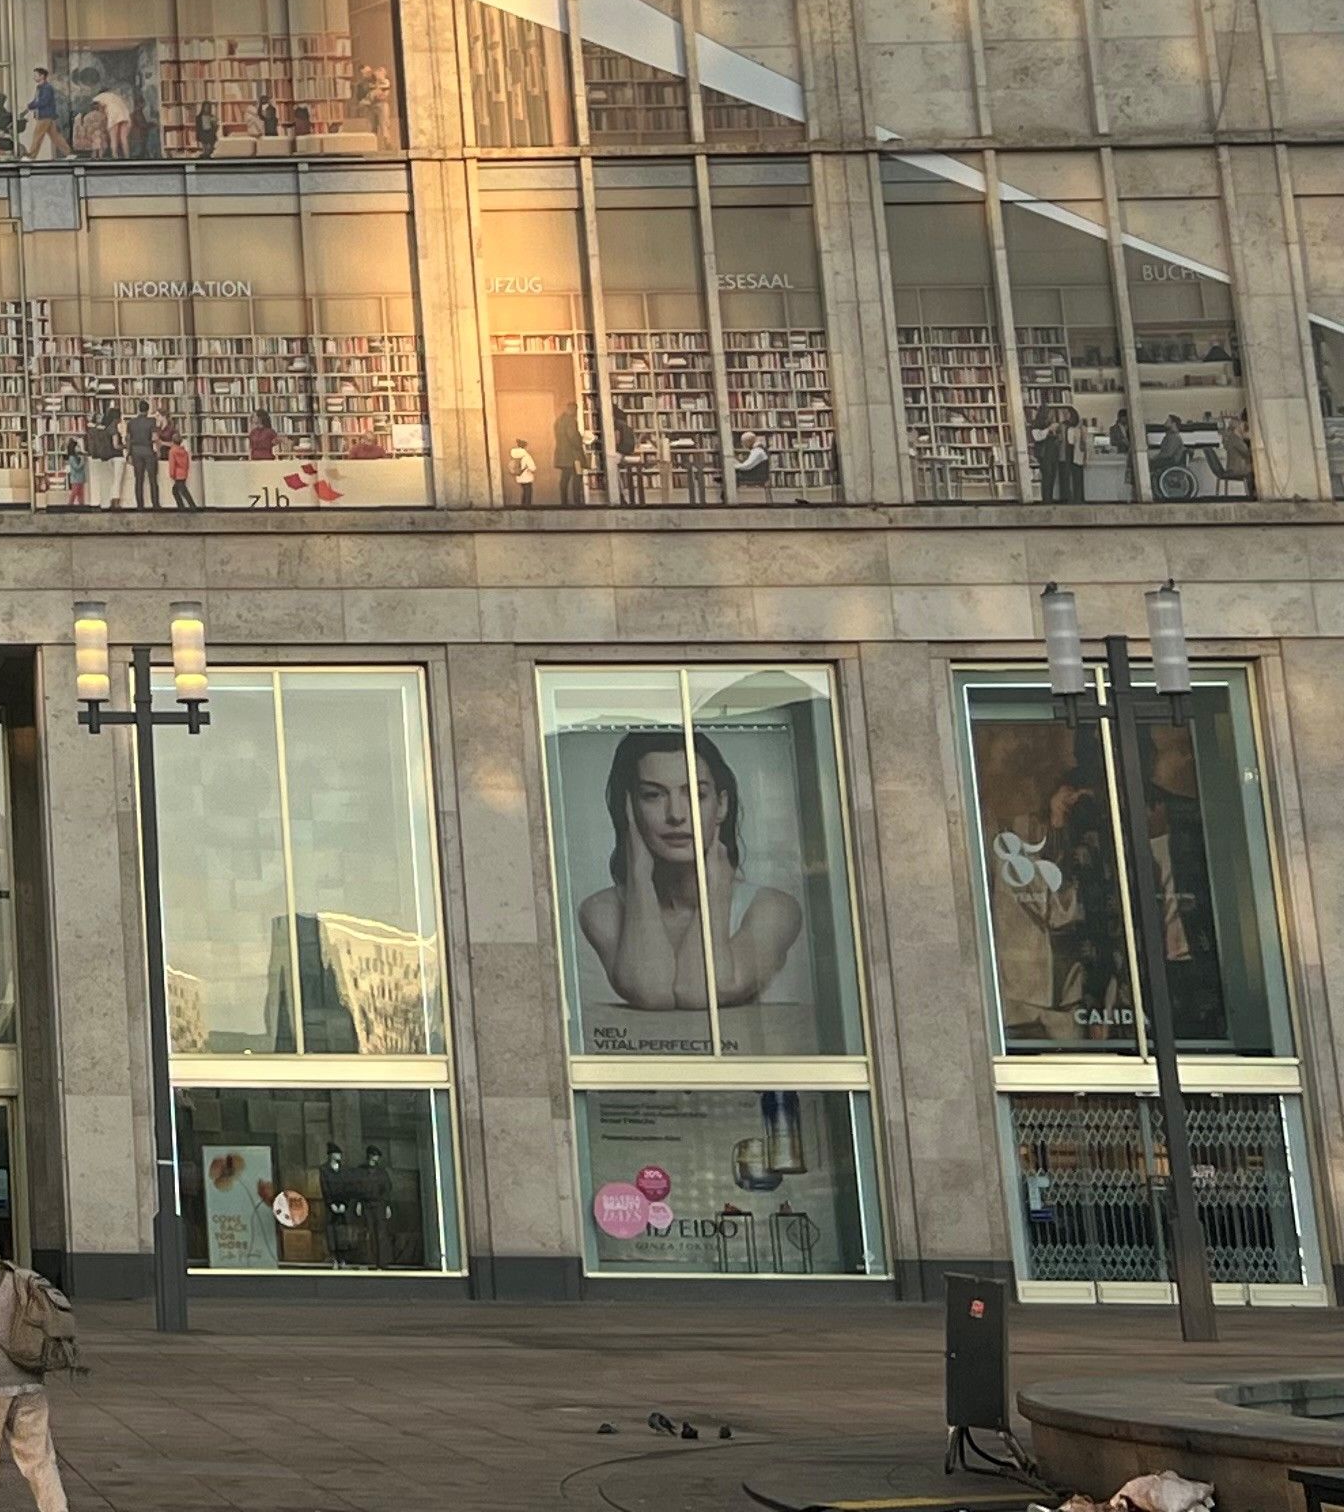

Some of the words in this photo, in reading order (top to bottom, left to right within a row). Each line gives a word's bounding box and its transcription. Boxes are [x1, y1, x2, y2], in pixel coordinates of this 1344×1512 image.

[113, 279, 253, 299] INFORMATION
[1073, 1008, 1151, 1026] CALID
[593, 1027, 628, 1039] NEU
[638, 1039, 739, 1052] PERFECTON
